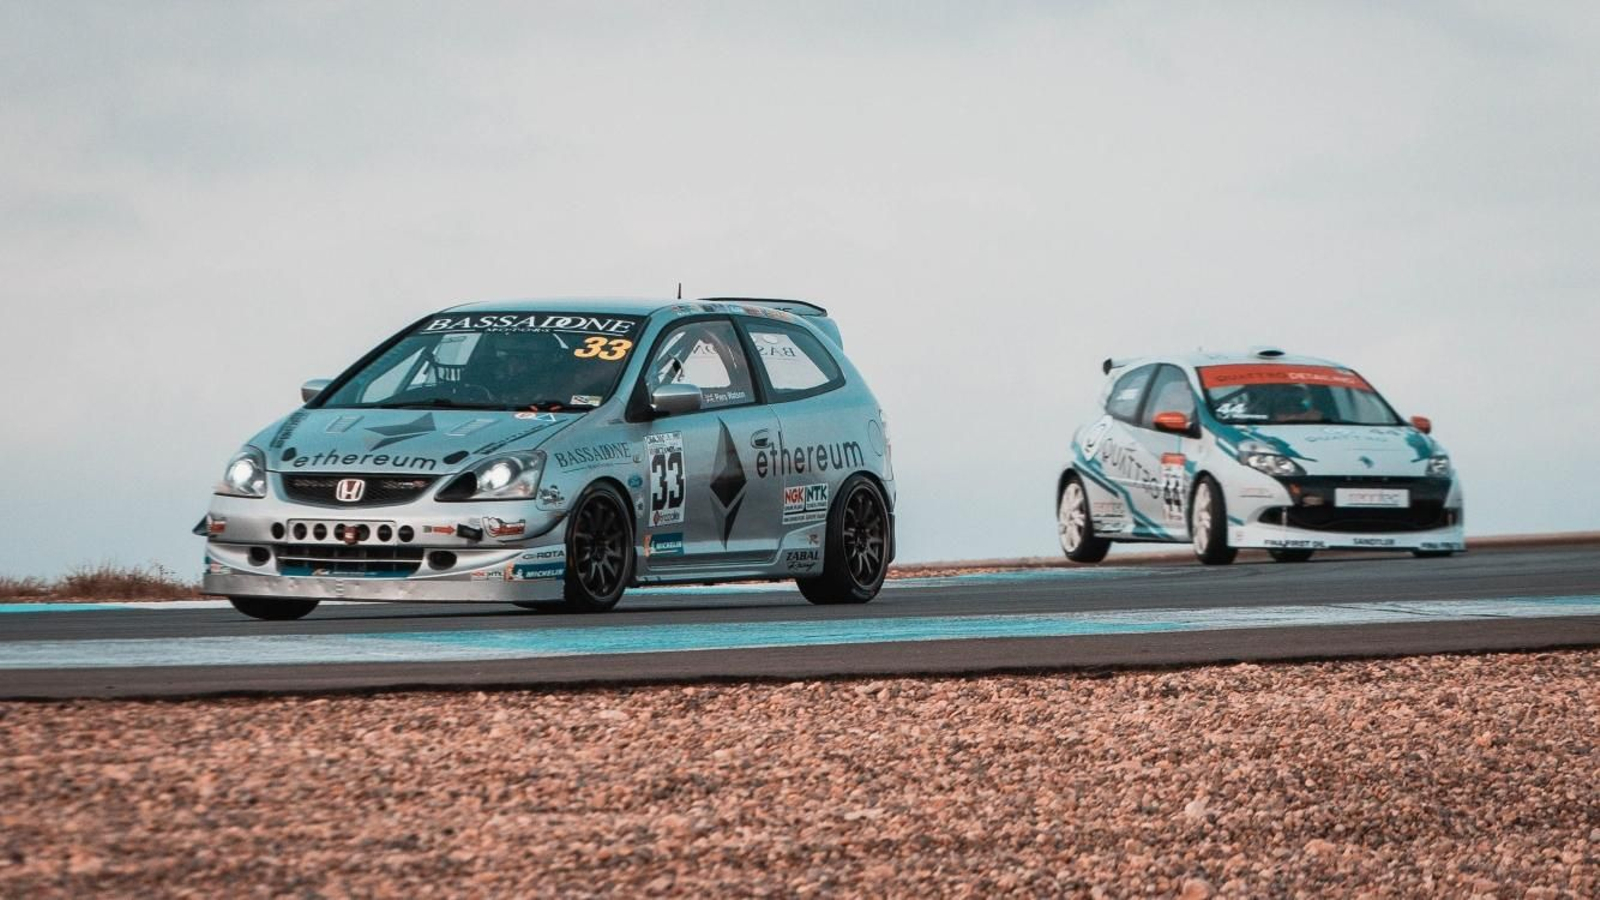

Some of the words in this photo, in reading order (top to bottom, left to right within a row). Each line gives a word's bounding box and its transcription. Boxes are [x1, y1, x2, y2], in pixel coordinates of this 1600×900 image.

[425, 315, 635, 334] BASSADONE
[574, 336, 633, 361] 33
[1215, 402, 1247, 414] 44
[293, 449, 437, 470] ethereum
[554, 442, 633, 468] BASSADONE
[756, 431, 865, 478] ethereum
[651, 452, 685, 512] 33
[785, 487, 804, 504] NGK
[806, 485, 827, 502] NTK
[537, 551, 565, 559] ROTA
[786, 550, 820, 561] ZABAL
[525, 568, 564, 578] MICHELIN
